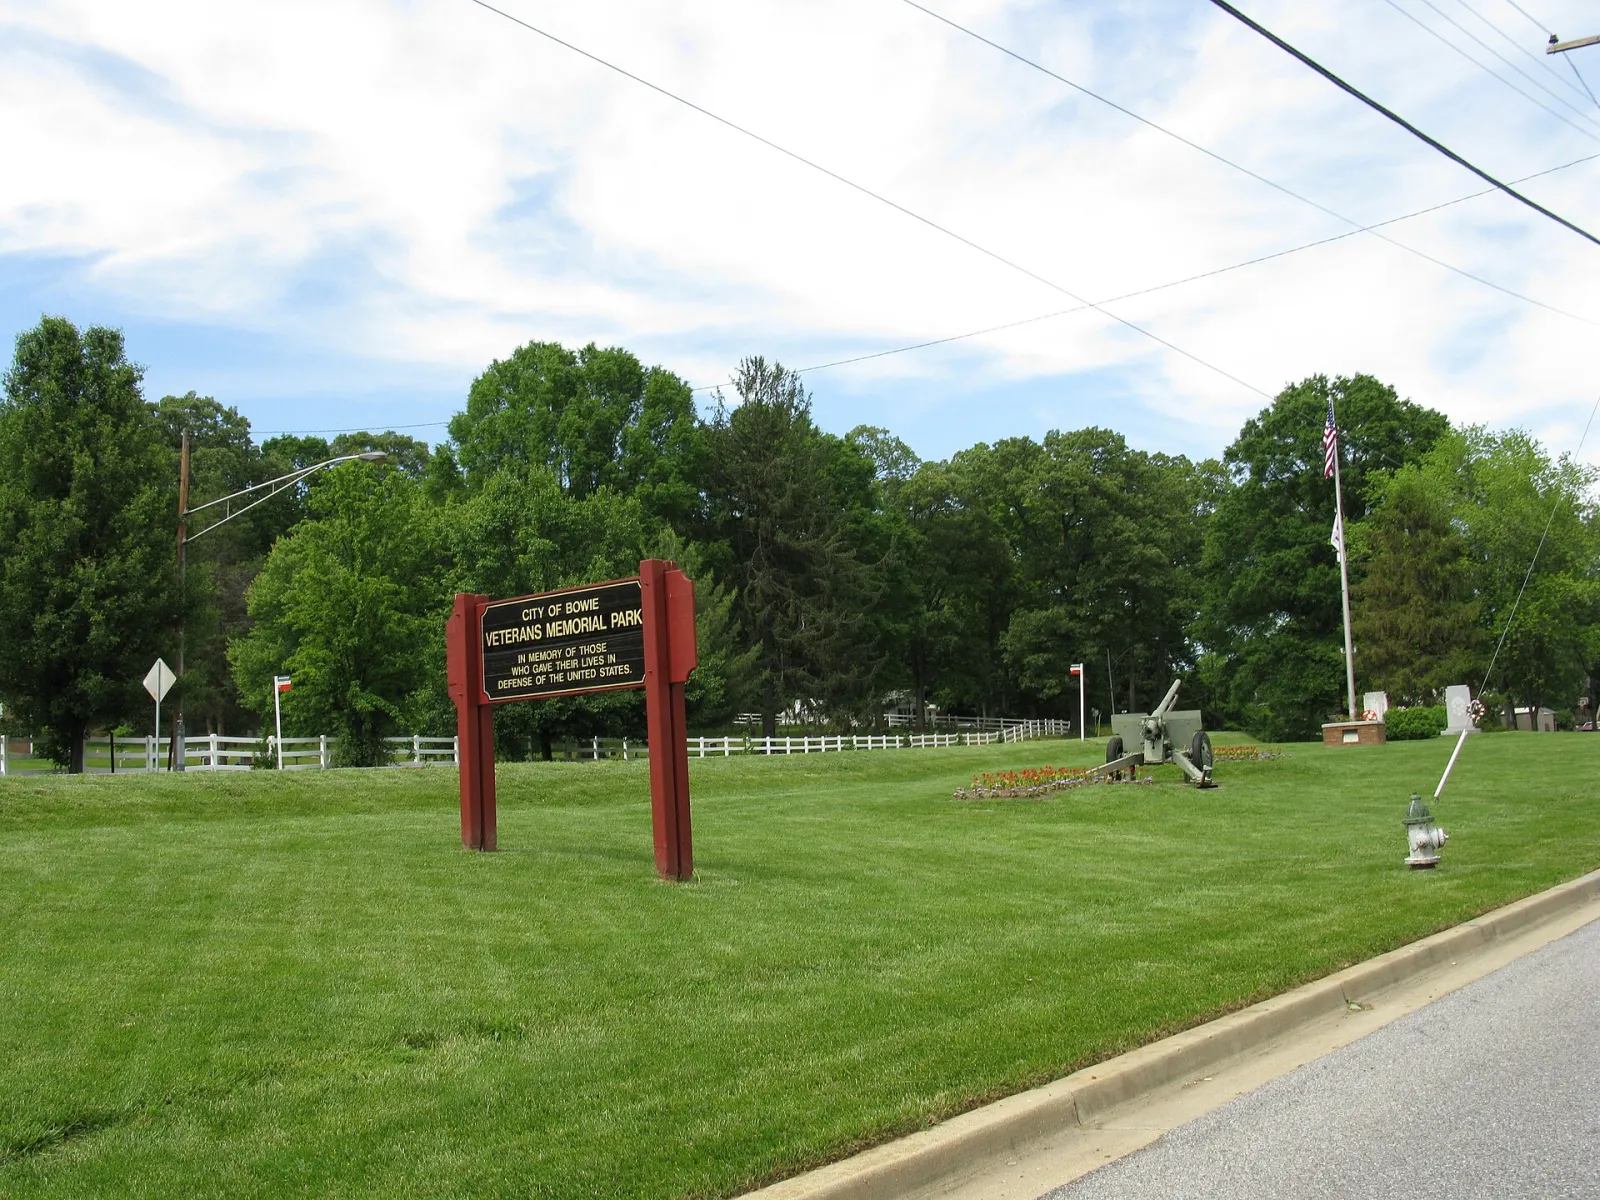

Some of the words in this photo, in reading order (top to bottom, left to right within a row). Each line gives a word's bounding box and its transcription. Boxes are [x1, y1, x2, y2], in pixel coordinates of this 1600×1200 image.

[522, 606, 544, 622] CITY
[548, 603, 562, 616] OF
[566, 598, 600, 613] BOWIE
[486, 624, 542, 647] VETERANS
[546, 615, 608, 638] MEMORIAL
[611, 608, 643, 628] PARK
[512, 665, 530, 676] WHO
[532, 662, 553, 674] GAVE
[556, 658, 579, 671] THEIR
[582, 655, 605, 667] LIVES
[607, 654, 616, 664] IN
[518, 654, 526, 664] IN
[528, 649, 562, 662] MEMORY
[566, 646, 576, 658] OF
[579, 642, 608, 655] THOSE
[498, 678, 532, 690] DEFENSE
[536, 674, 546, 686] OF
[549, 672, 564, 684] THE
[567, 668, 597, 682] UNITED
[600, 664, 632, 678] STATES.
